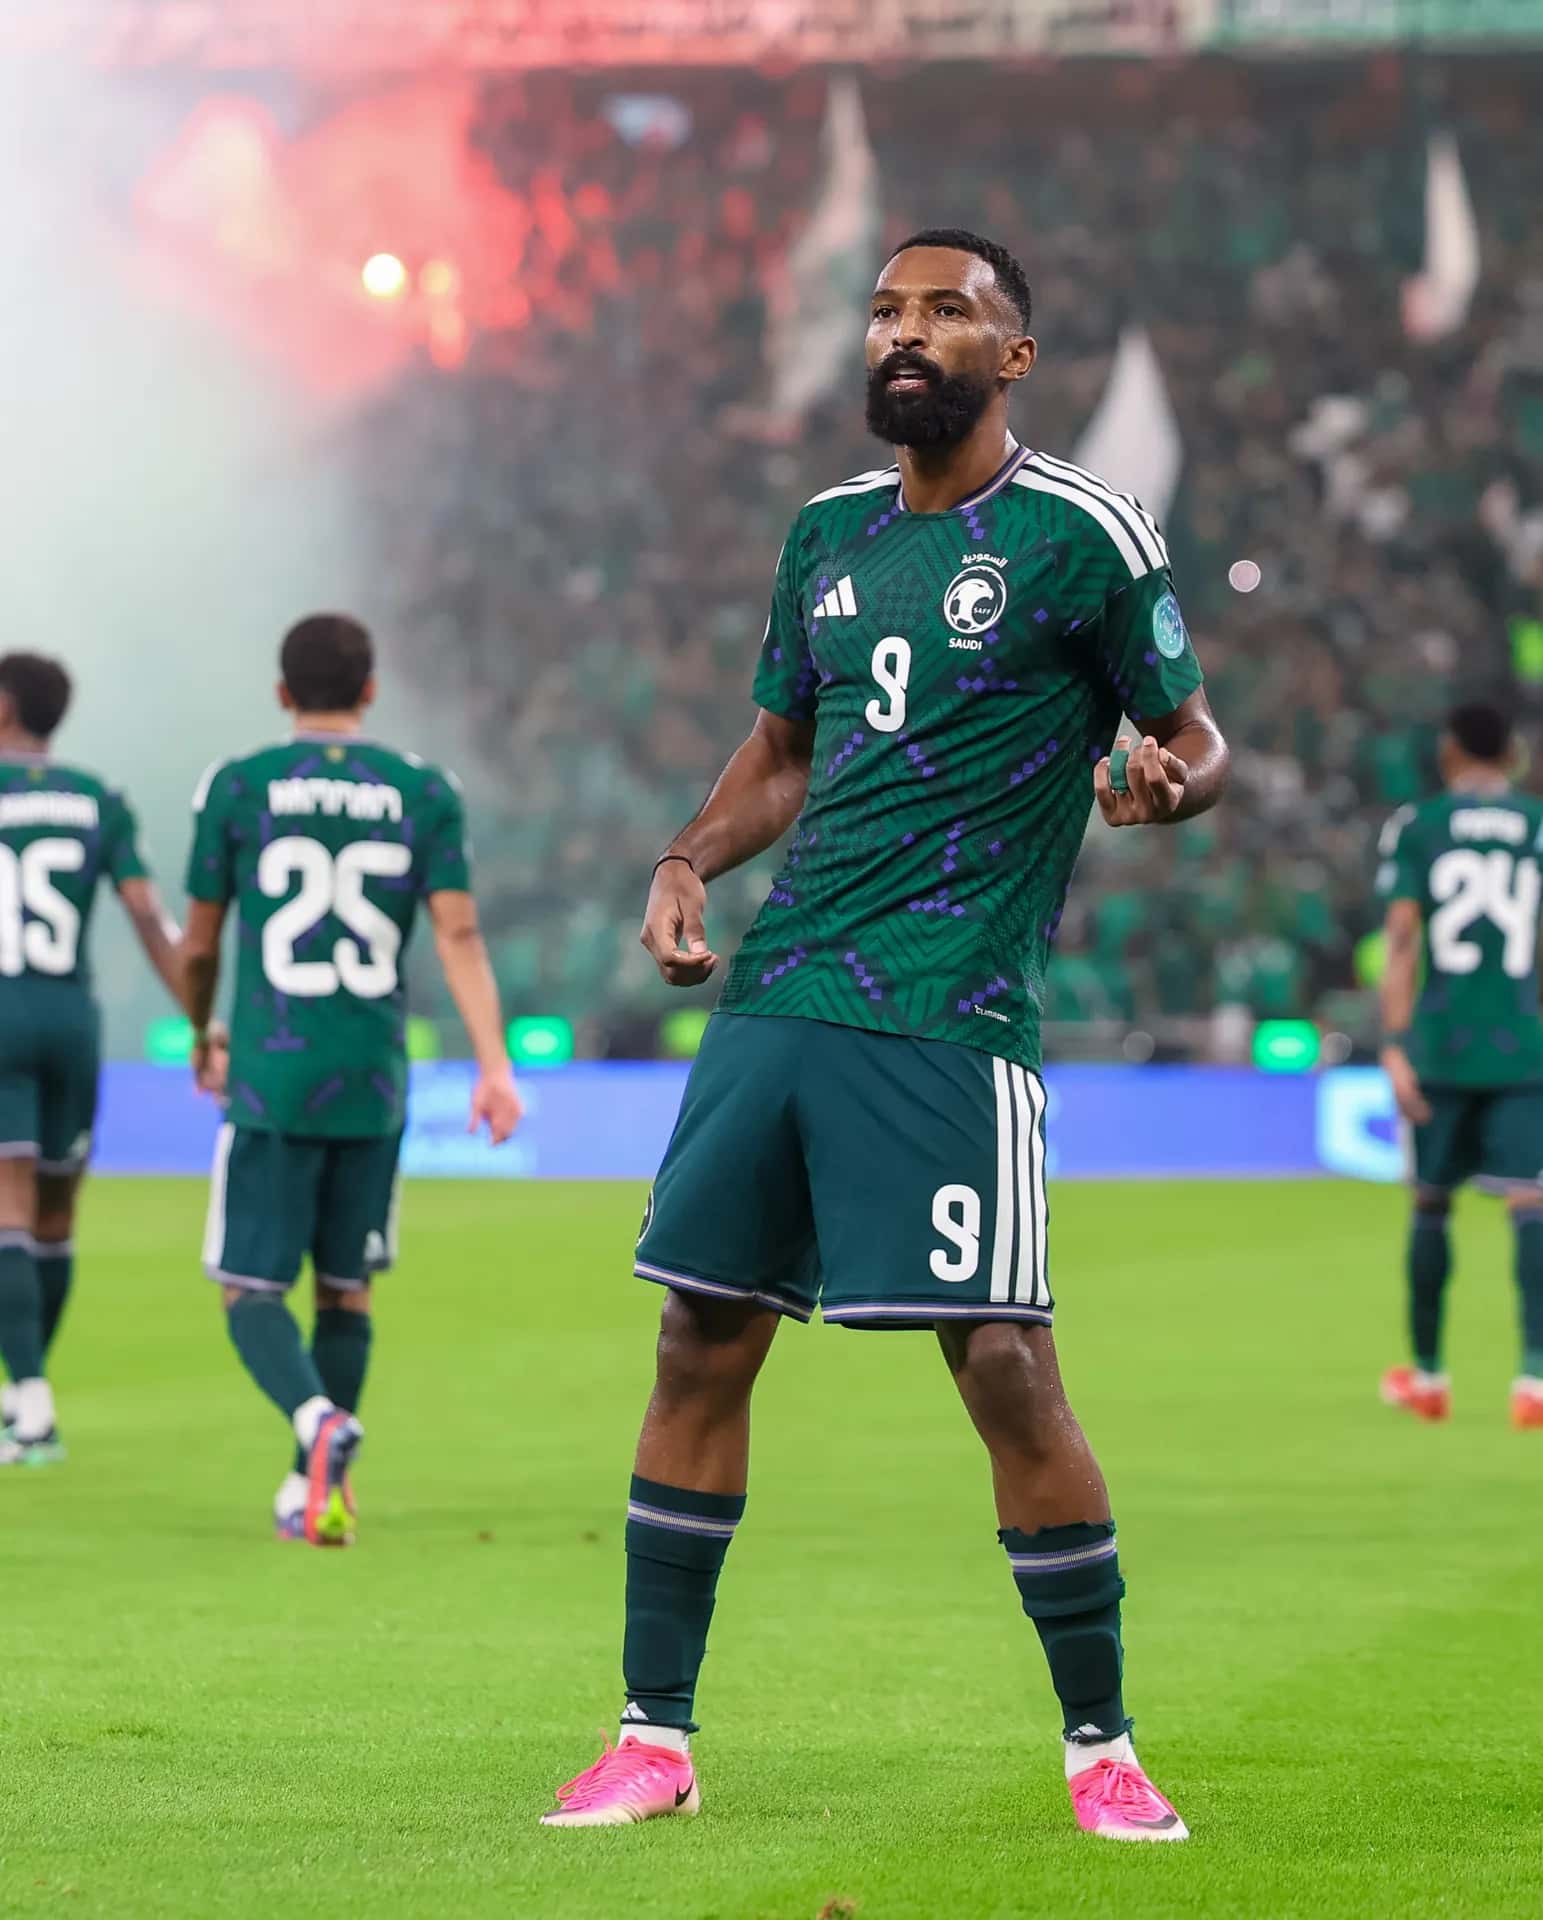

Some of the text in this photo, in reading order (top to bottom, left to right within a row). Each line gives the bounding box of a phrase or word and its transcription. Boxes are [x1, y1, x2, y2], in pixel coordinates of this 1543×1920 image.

[961, 553, 1008, 568] السعودية
[865, 636, 911, 732] 9
[948, 637, 983, 651] SAUDI
[258, 836, 412, 998] 25
[1429, 848, 1541, 979] 24
[929, 1184, 980, 1282] 9
